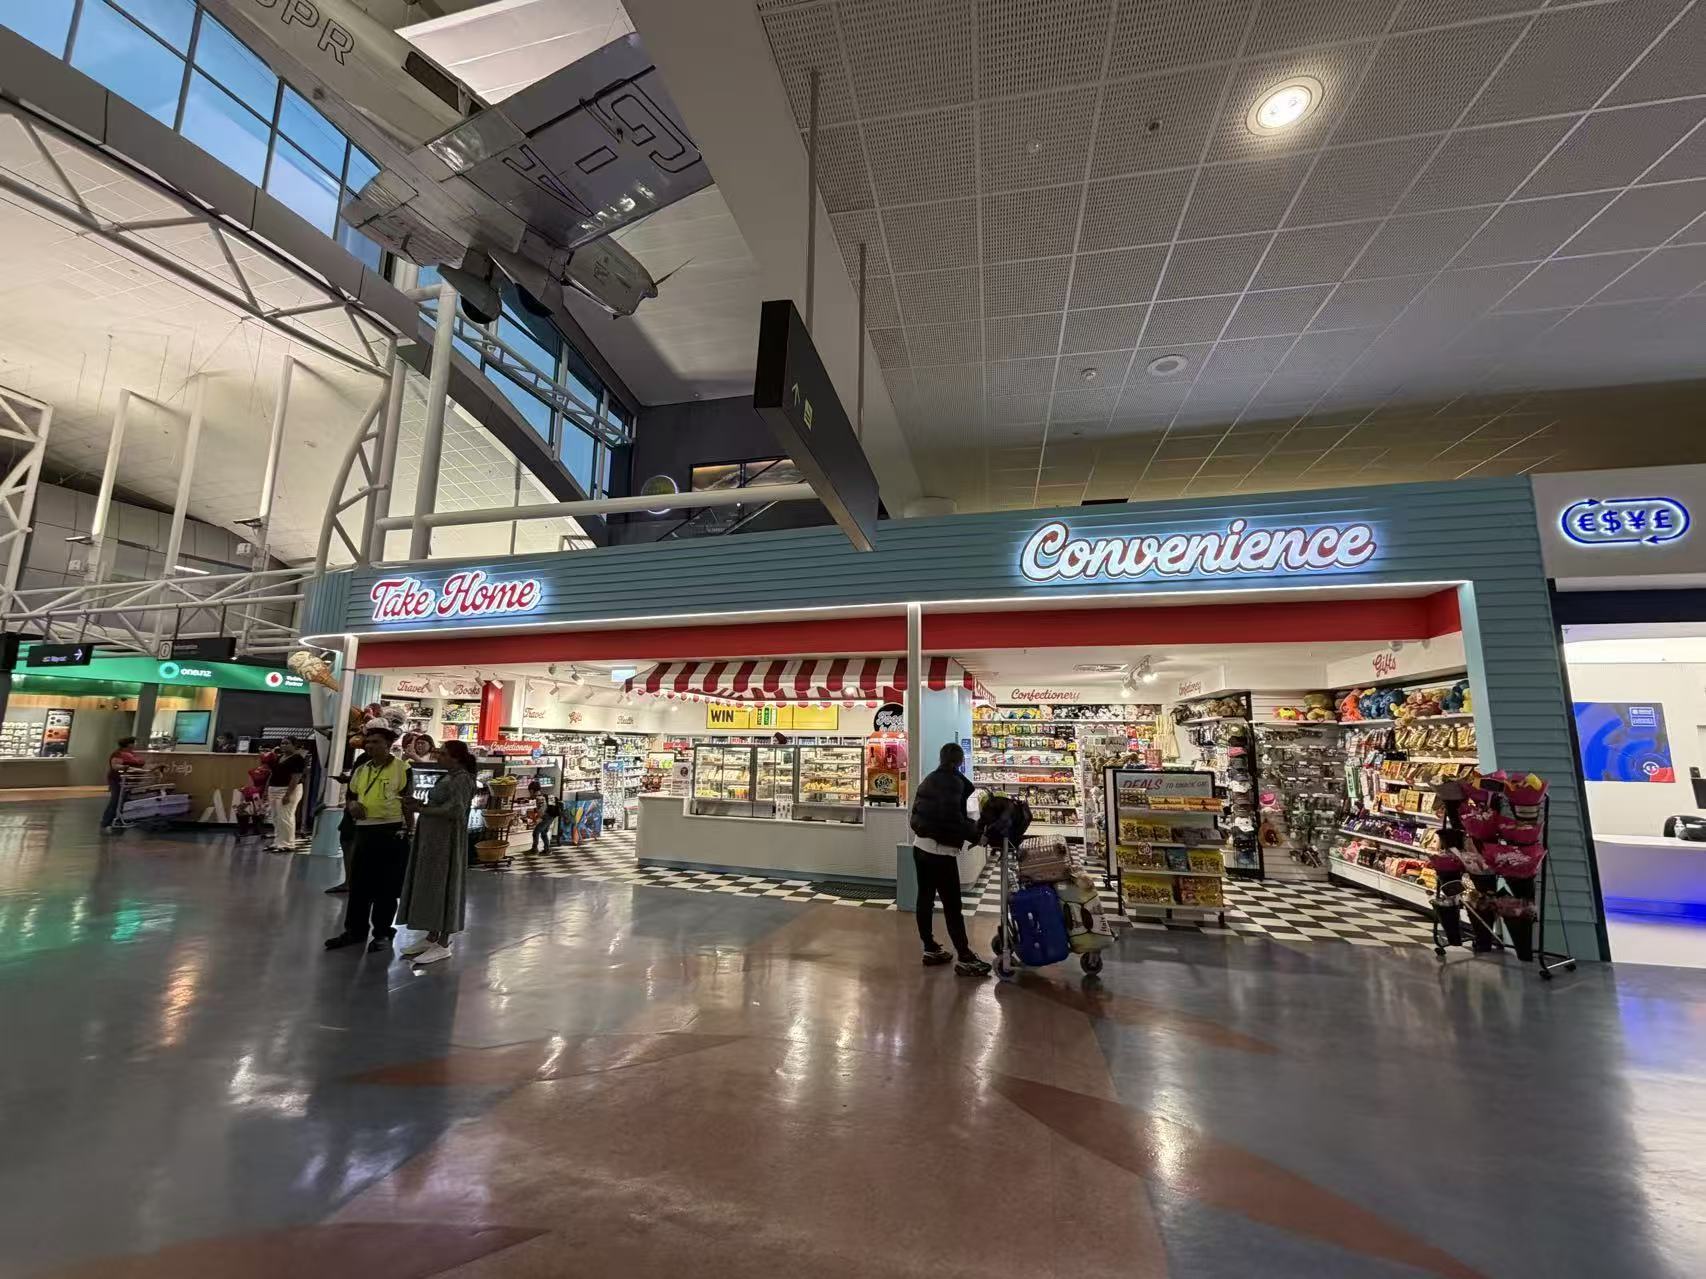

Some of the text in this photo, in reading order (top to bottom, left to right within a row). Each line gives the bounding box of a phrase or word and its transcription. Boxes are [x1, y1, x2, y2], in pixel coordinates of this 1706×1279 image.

[1020, 518, 1377, 583] Convenience
[371, 570, 542, 621] Take Home
[1372, 653, 1397, 678] Gifts
[397, 680, 427, 693] Travel
[454, 684, 480, 695] Books
[1011, 688, 1080, 702] Confectionery
[710, 709, 734, 723] WIN
[171, 760, 193, 776] help
